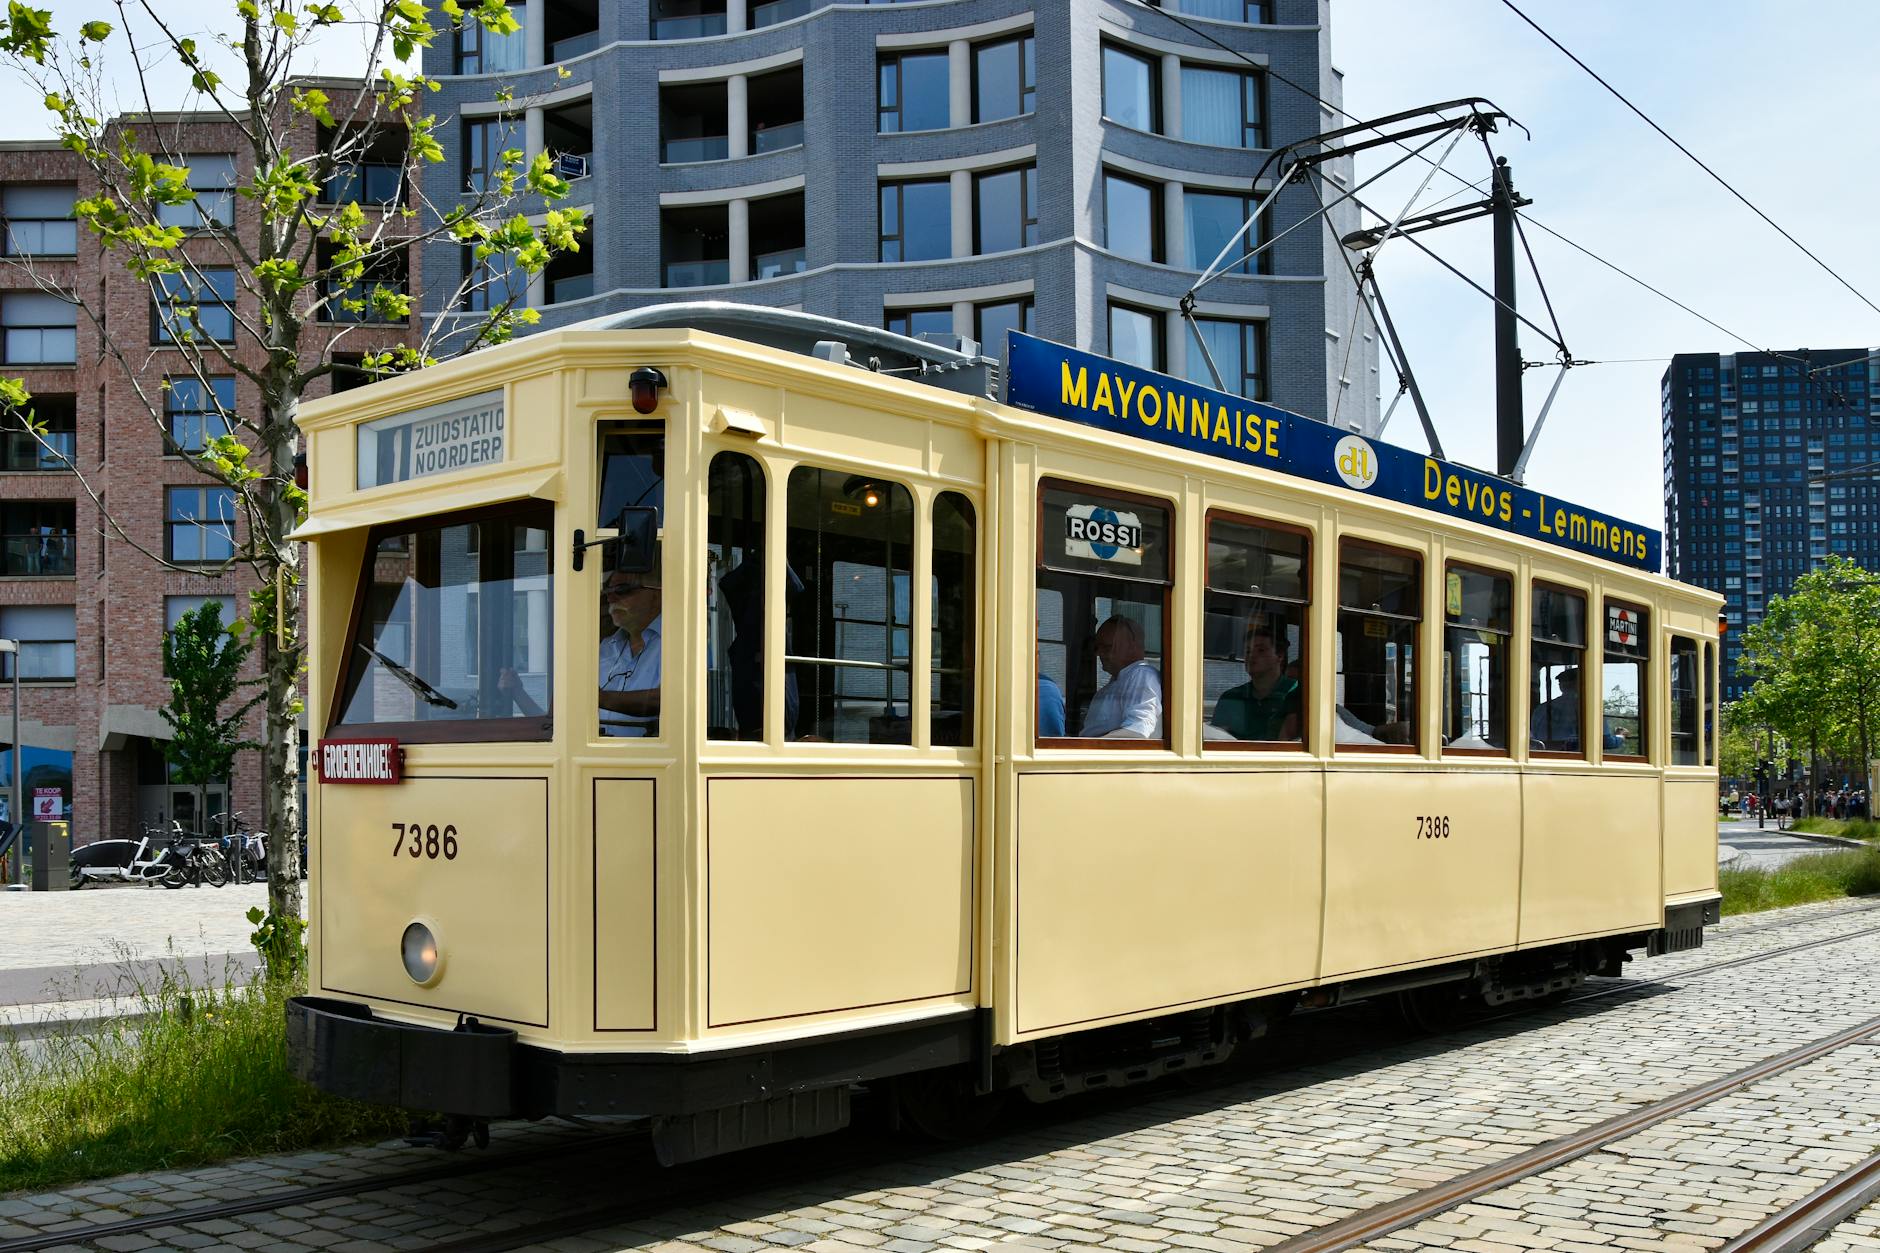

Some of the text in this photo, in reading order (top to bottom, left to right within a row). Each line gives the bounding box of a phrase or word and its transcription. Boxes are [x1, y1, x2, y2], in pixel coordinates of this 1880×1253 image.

[1061, 361, 1280, 458] MAYONNAISE
[393, 429, 403, 483] 1
[415, 436, 503, 475] NOORDERP
[1071, 518, 1137, 547] ROSSI
[1609, 617, 1637, 635] MARTINI
[392, 823, 458, 861] 7386
[1416, 815, 1450, 839] 7386
